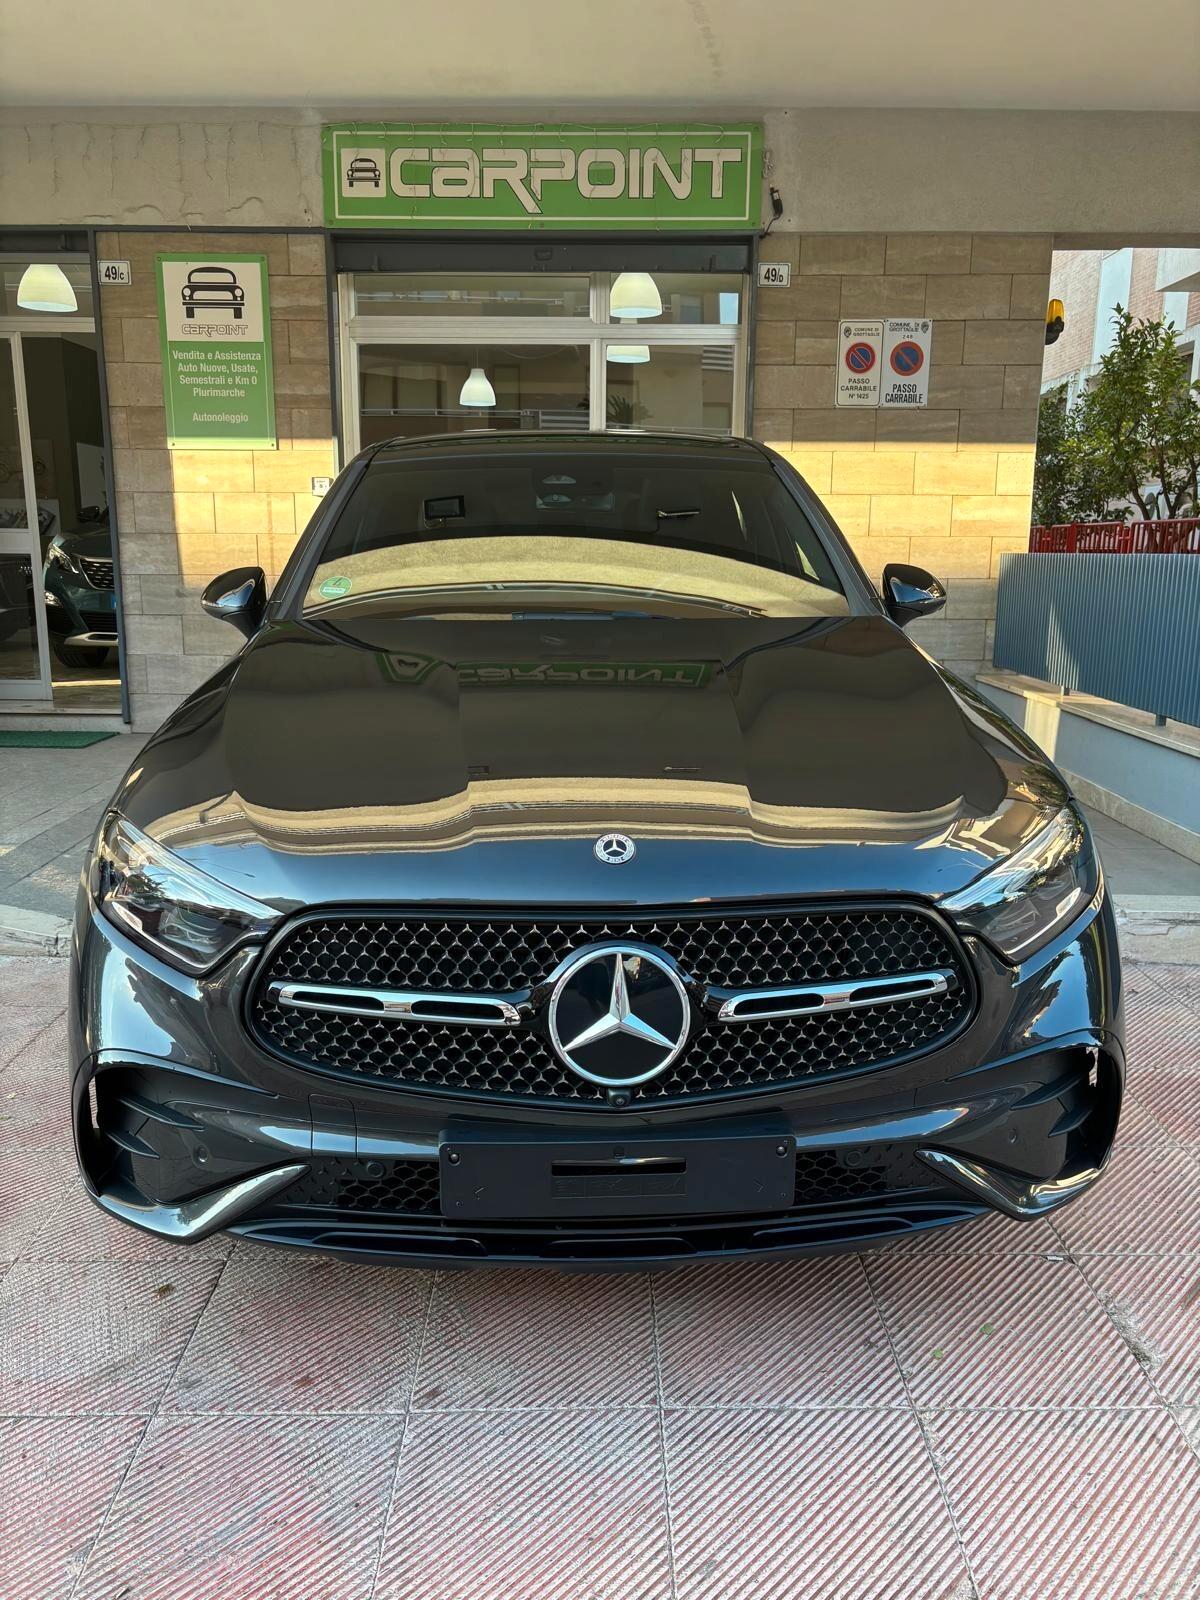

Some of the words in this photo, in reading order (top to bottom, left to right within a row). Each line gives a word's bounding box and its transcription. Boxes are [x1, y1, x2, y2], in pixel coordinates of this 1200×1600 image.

[172, 350, 205, 360] Vendita
[207, 352, 213, 360] e
[214, 350, 262, 361] Assistenza
[178, 362, 198, 372] Auto
[200, 362, 230, 374] Nuove,
[231, 363, 258, 375] Usate,
[180, 375, 226, 385] Semestrali
[227, 377, 233, 385] e
[235, 375, 250, 385] Km
[251, 375, 258, 385] 0
[193, 387, 246, 398] Plurimarche
[892, 383, 917, 394] PASSO
[885, 393, 924, 404] CARRABILE
[192, 412, 249, 424] Autonoleggio
